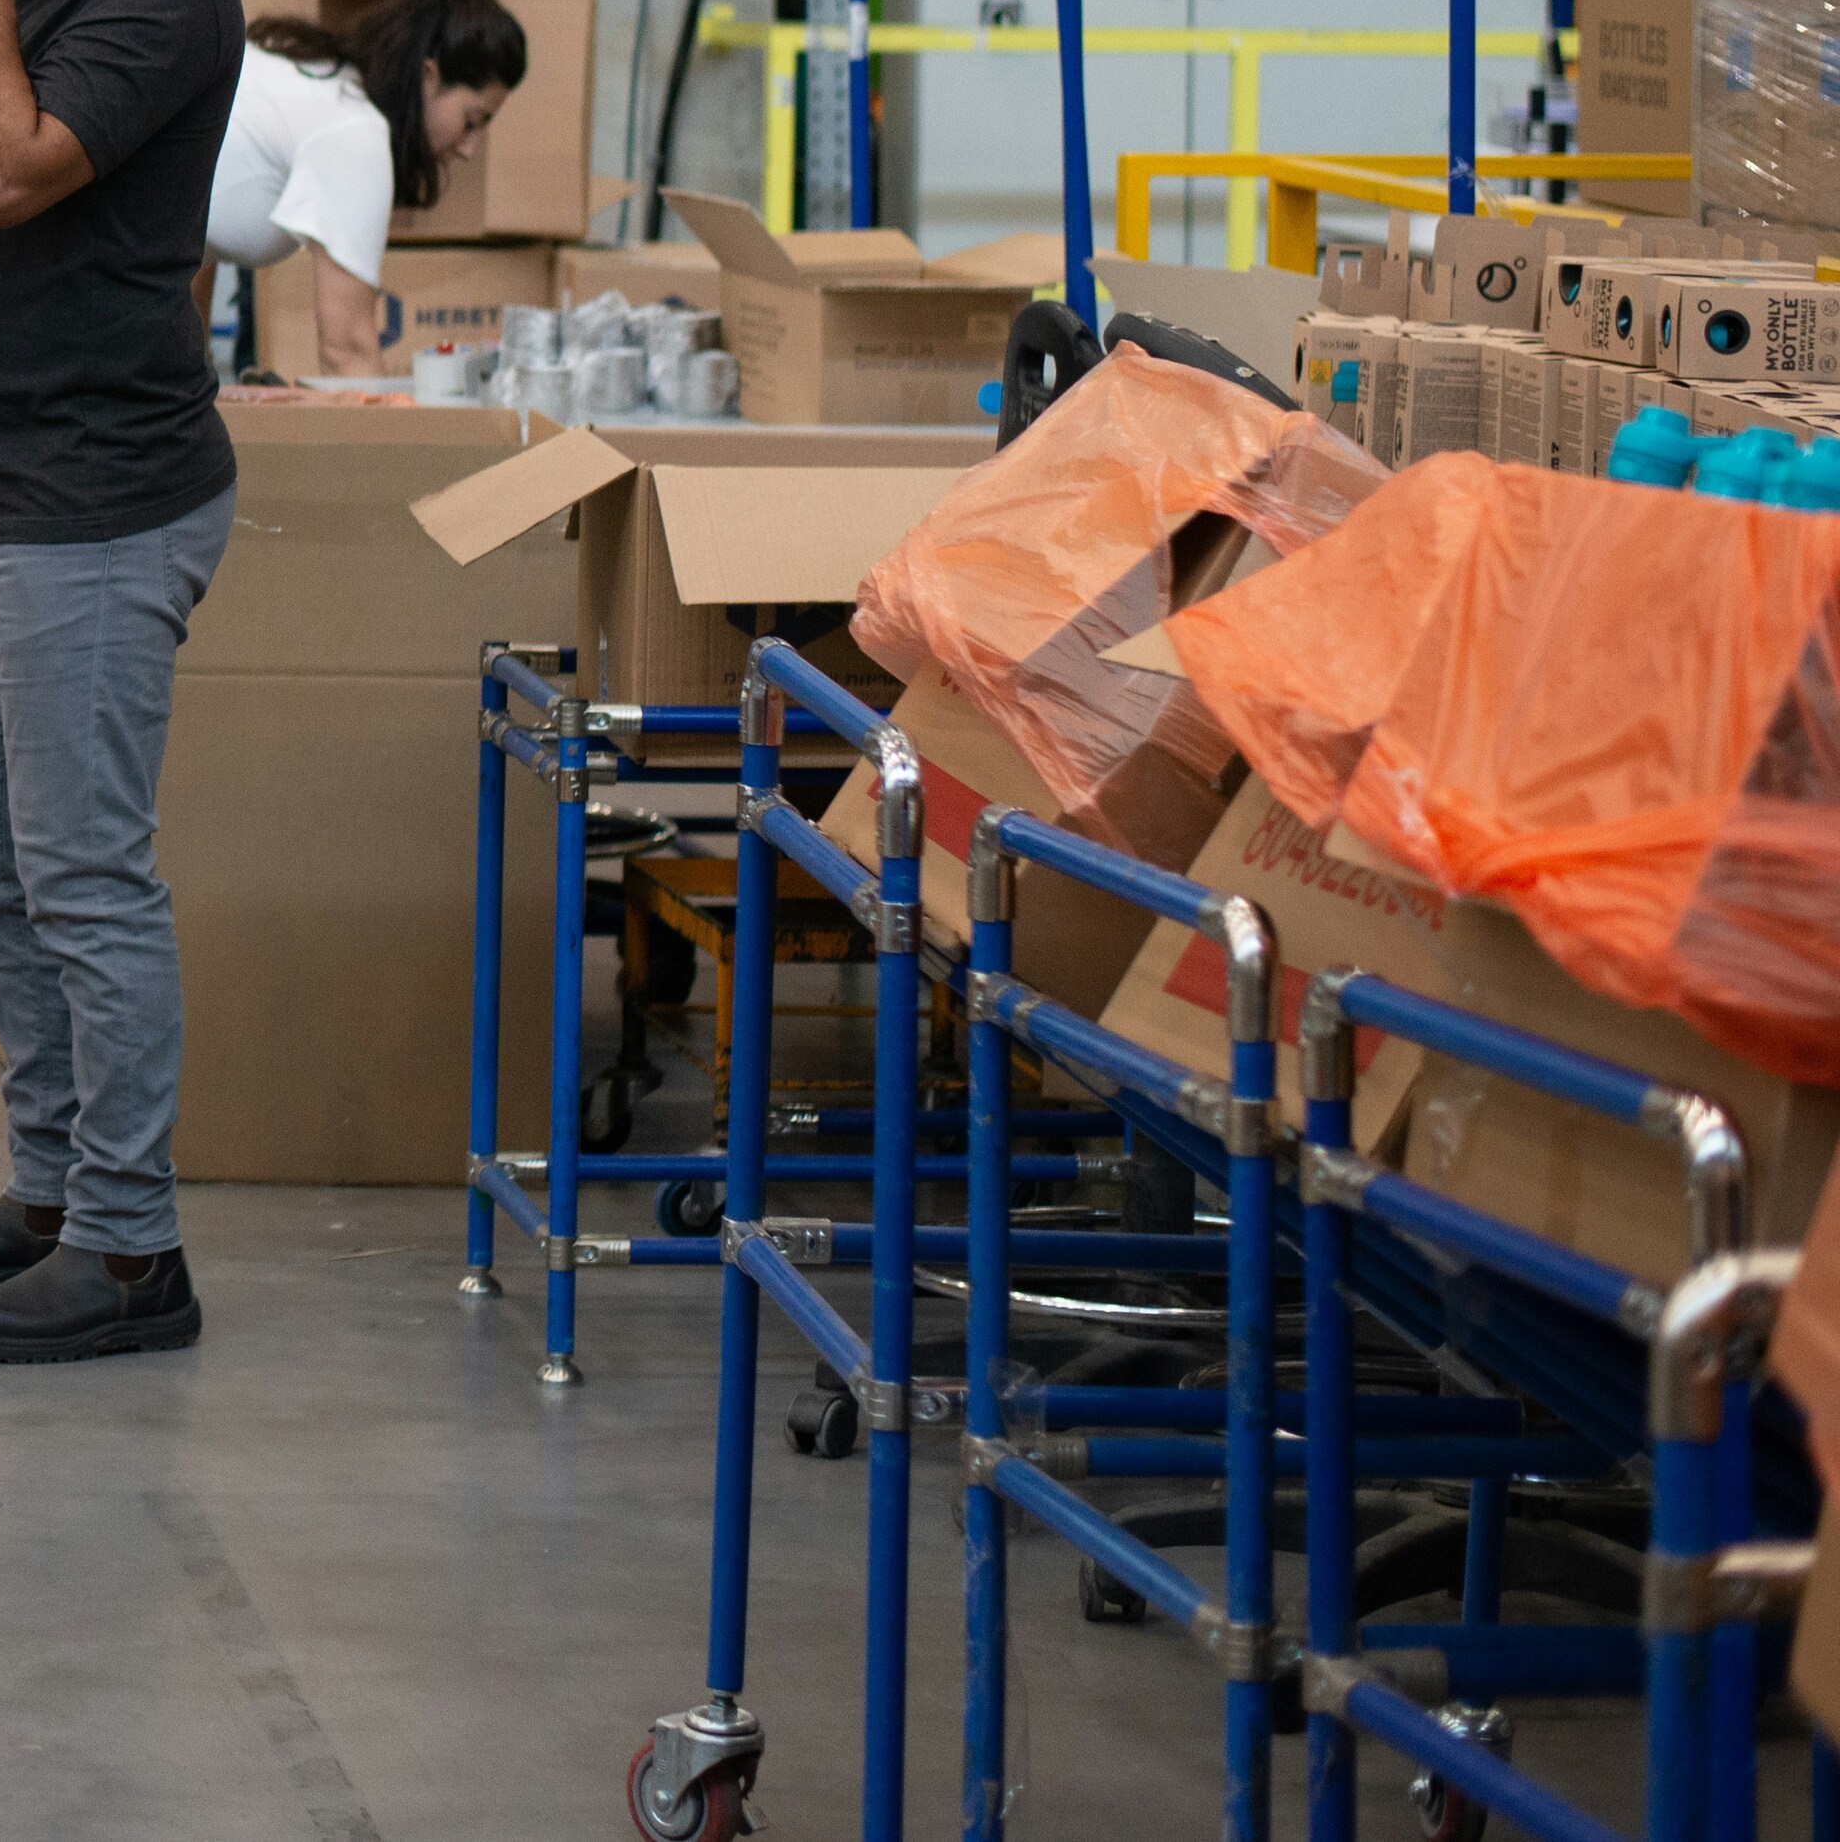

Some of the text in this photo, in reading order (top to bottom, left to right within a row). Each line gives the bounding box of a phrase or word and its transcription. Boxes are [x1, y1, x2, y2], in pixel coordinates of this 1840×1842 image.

[1599, 18, 1668, 67] BOTTLES
[1765, 298, 1781, 371] MY ONLY
[1781, 298, 1799, 371] BOTTLE
[1798, 354, 1806, 372] FOR
[1799, 339, 1807, 352] MY
[1807, 299, 1817, 372] AND MY PLANET
